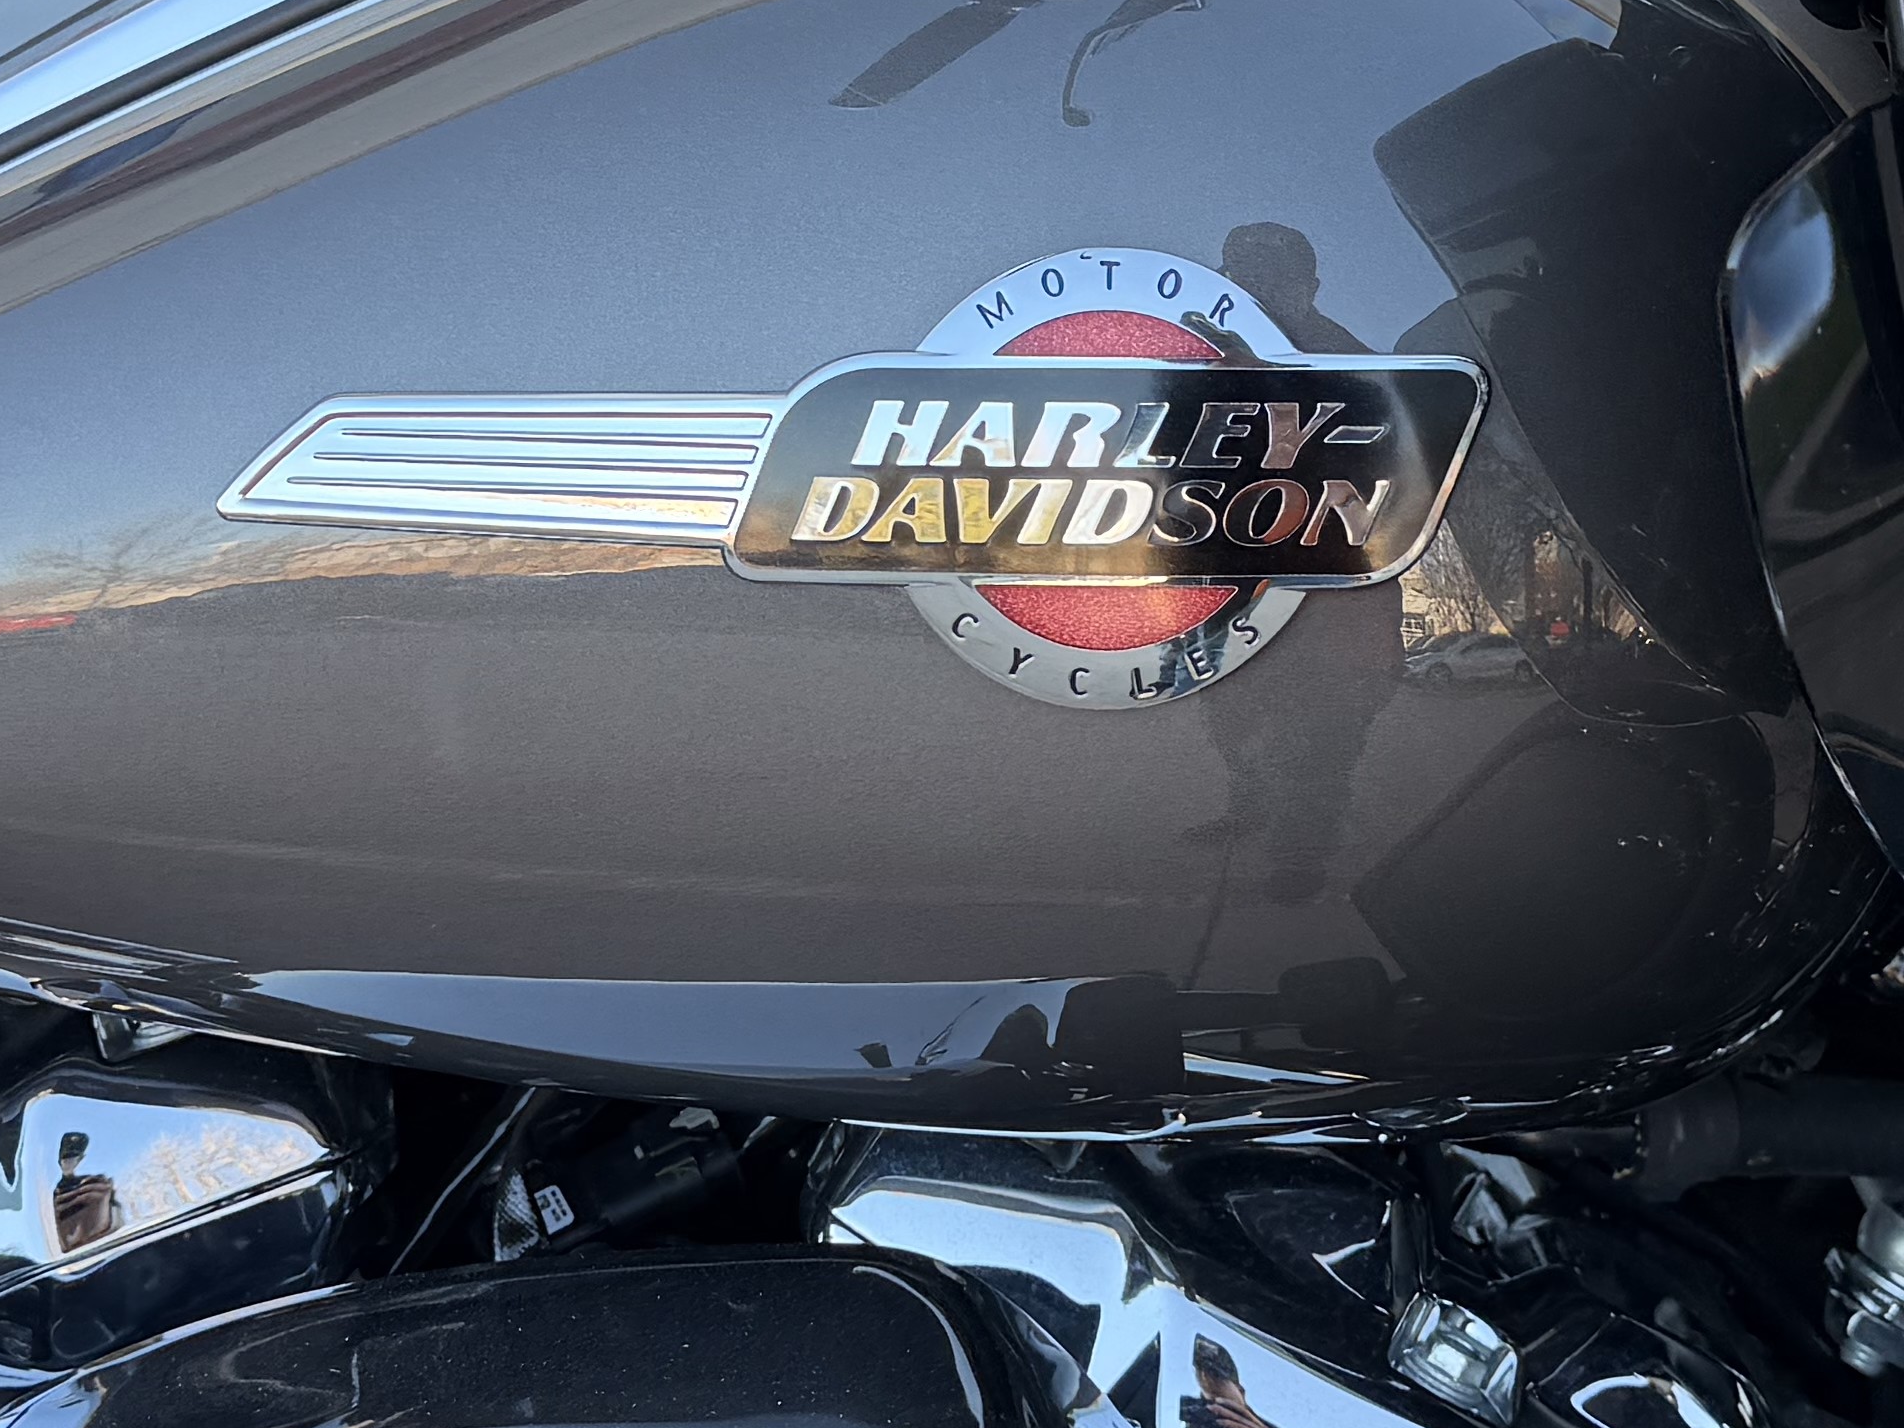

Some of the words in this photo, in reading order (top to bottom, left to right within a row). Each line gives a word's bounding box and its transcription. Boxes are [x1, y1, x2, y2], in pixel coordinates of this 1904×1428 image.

[976, 260, 1235, 329] MOTOR
[851, 400, 1392, 471] HARLEY-
[790, 476, 1391, 548] DAVIDSON
[951, 613, 1261, 700] CYCLES
